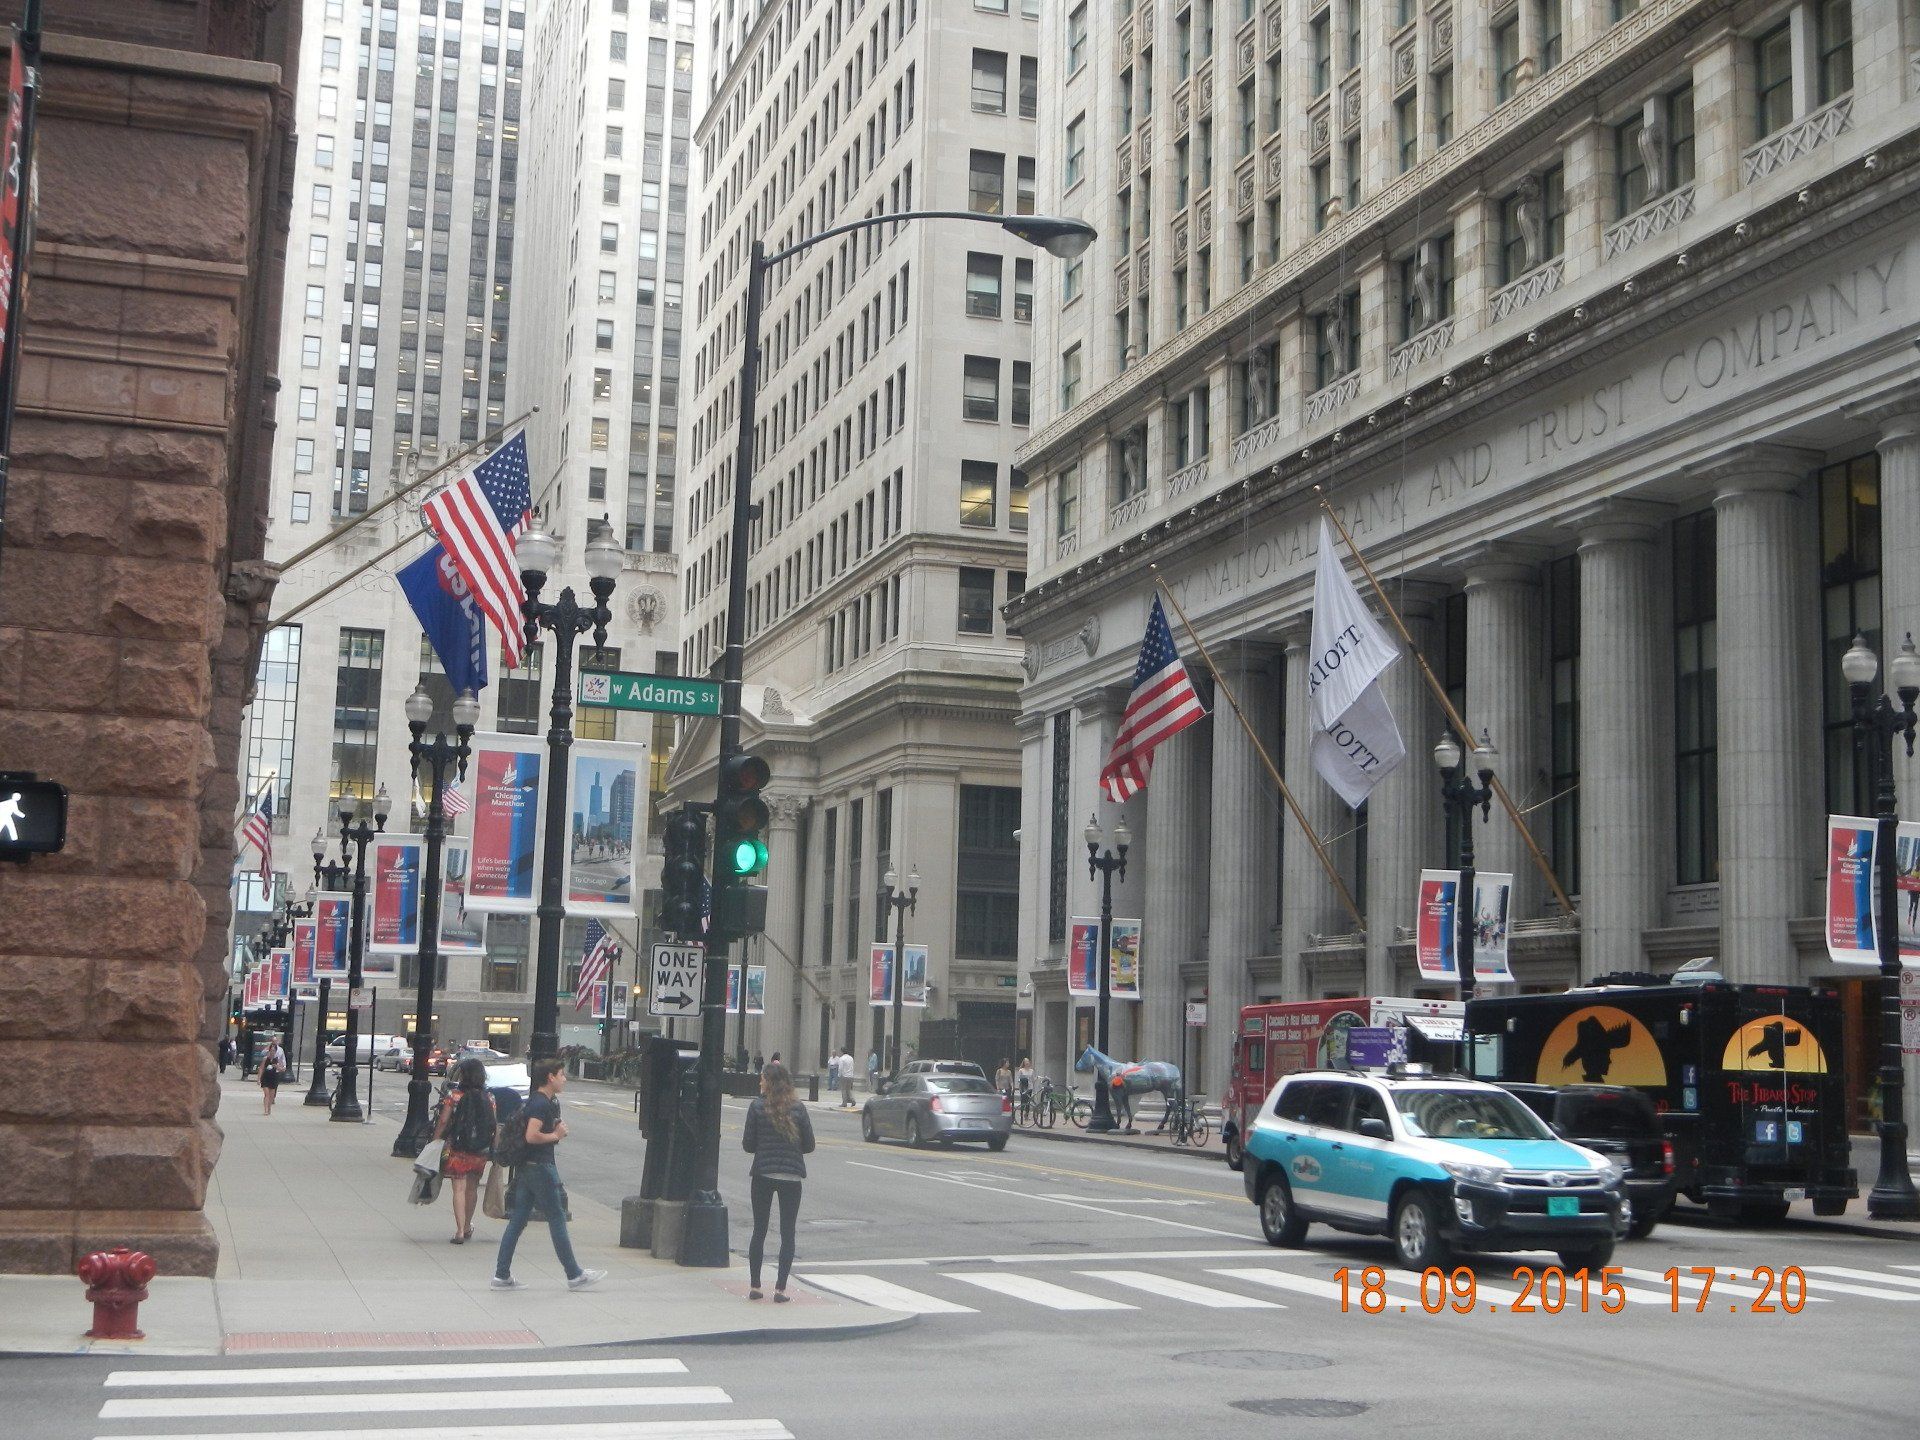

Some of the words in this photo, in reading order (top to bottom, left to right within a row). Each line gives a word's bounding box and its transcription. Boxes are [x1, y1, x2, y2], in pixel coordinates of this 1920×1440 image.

[1203, 519, 1320, 602] NATIONAL
[1331, 481, 1407, 546] BANK
[1427, 441, 1494, 507] AND
[1517, 373, 1634, 466] TRUST
[1659, 246, 1906, 404] COMPANY
[628, 681, 696, 706] Adams
[701, 692, 714, 703] St
[491, 799, 525, 808] Marathon
[494, 792, 522, 801] Chicago
[476, 872, 508, 880] connected
[659, 951, 698, 968] ONE
[657, 970, 698, 988] WAY
